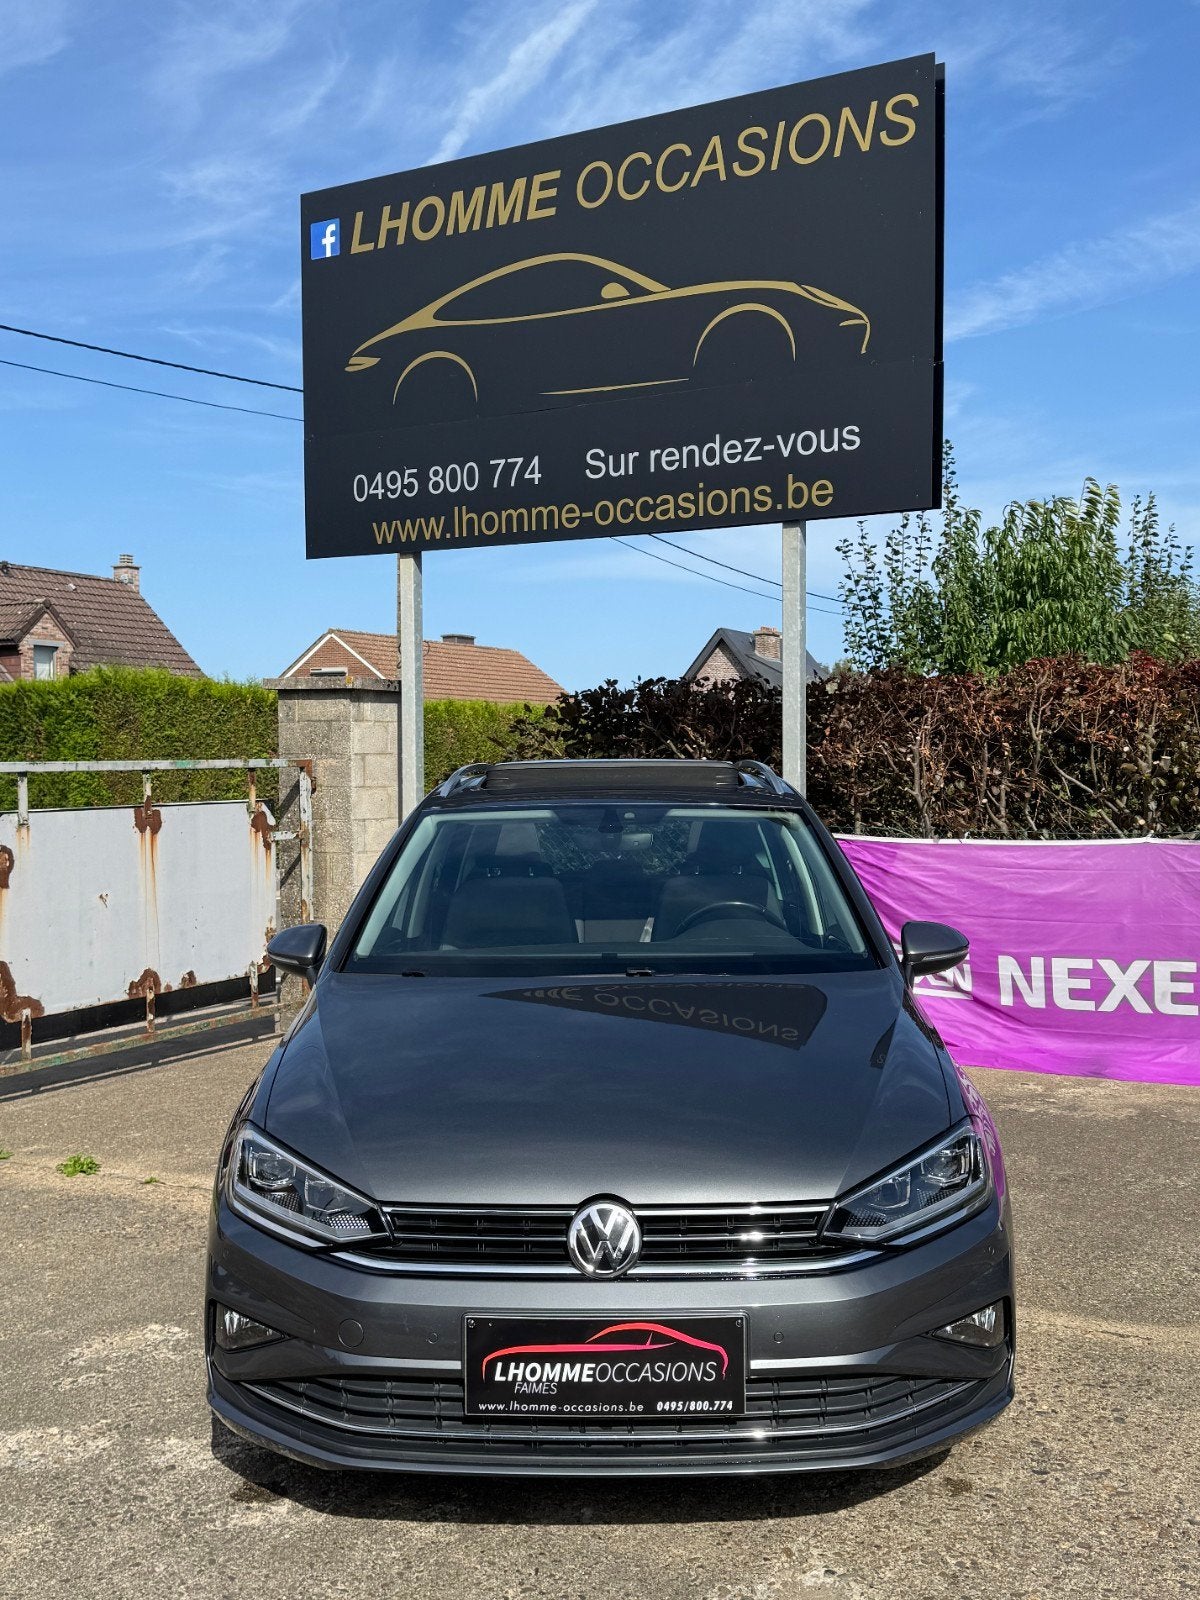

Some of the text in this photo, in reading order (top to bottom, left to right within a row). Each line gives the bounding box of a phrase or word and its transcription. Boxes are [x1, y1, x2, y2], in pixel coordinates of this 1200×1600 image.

[349, 169, 562, 255] LHOMME
[575, 92, 920, 210] OCCASIONS
[585, 425, 861, 480] Sur rendez-vous
[353, 455, 542, 503] 0495 800 774
[372, 473, 835, 546] www.lhomme-occasions.be
[478, 1400, 733, 1413] www.lhomme-occasions.be 0495/800.774
[514, 1382, 558, 1395] FAIMES
